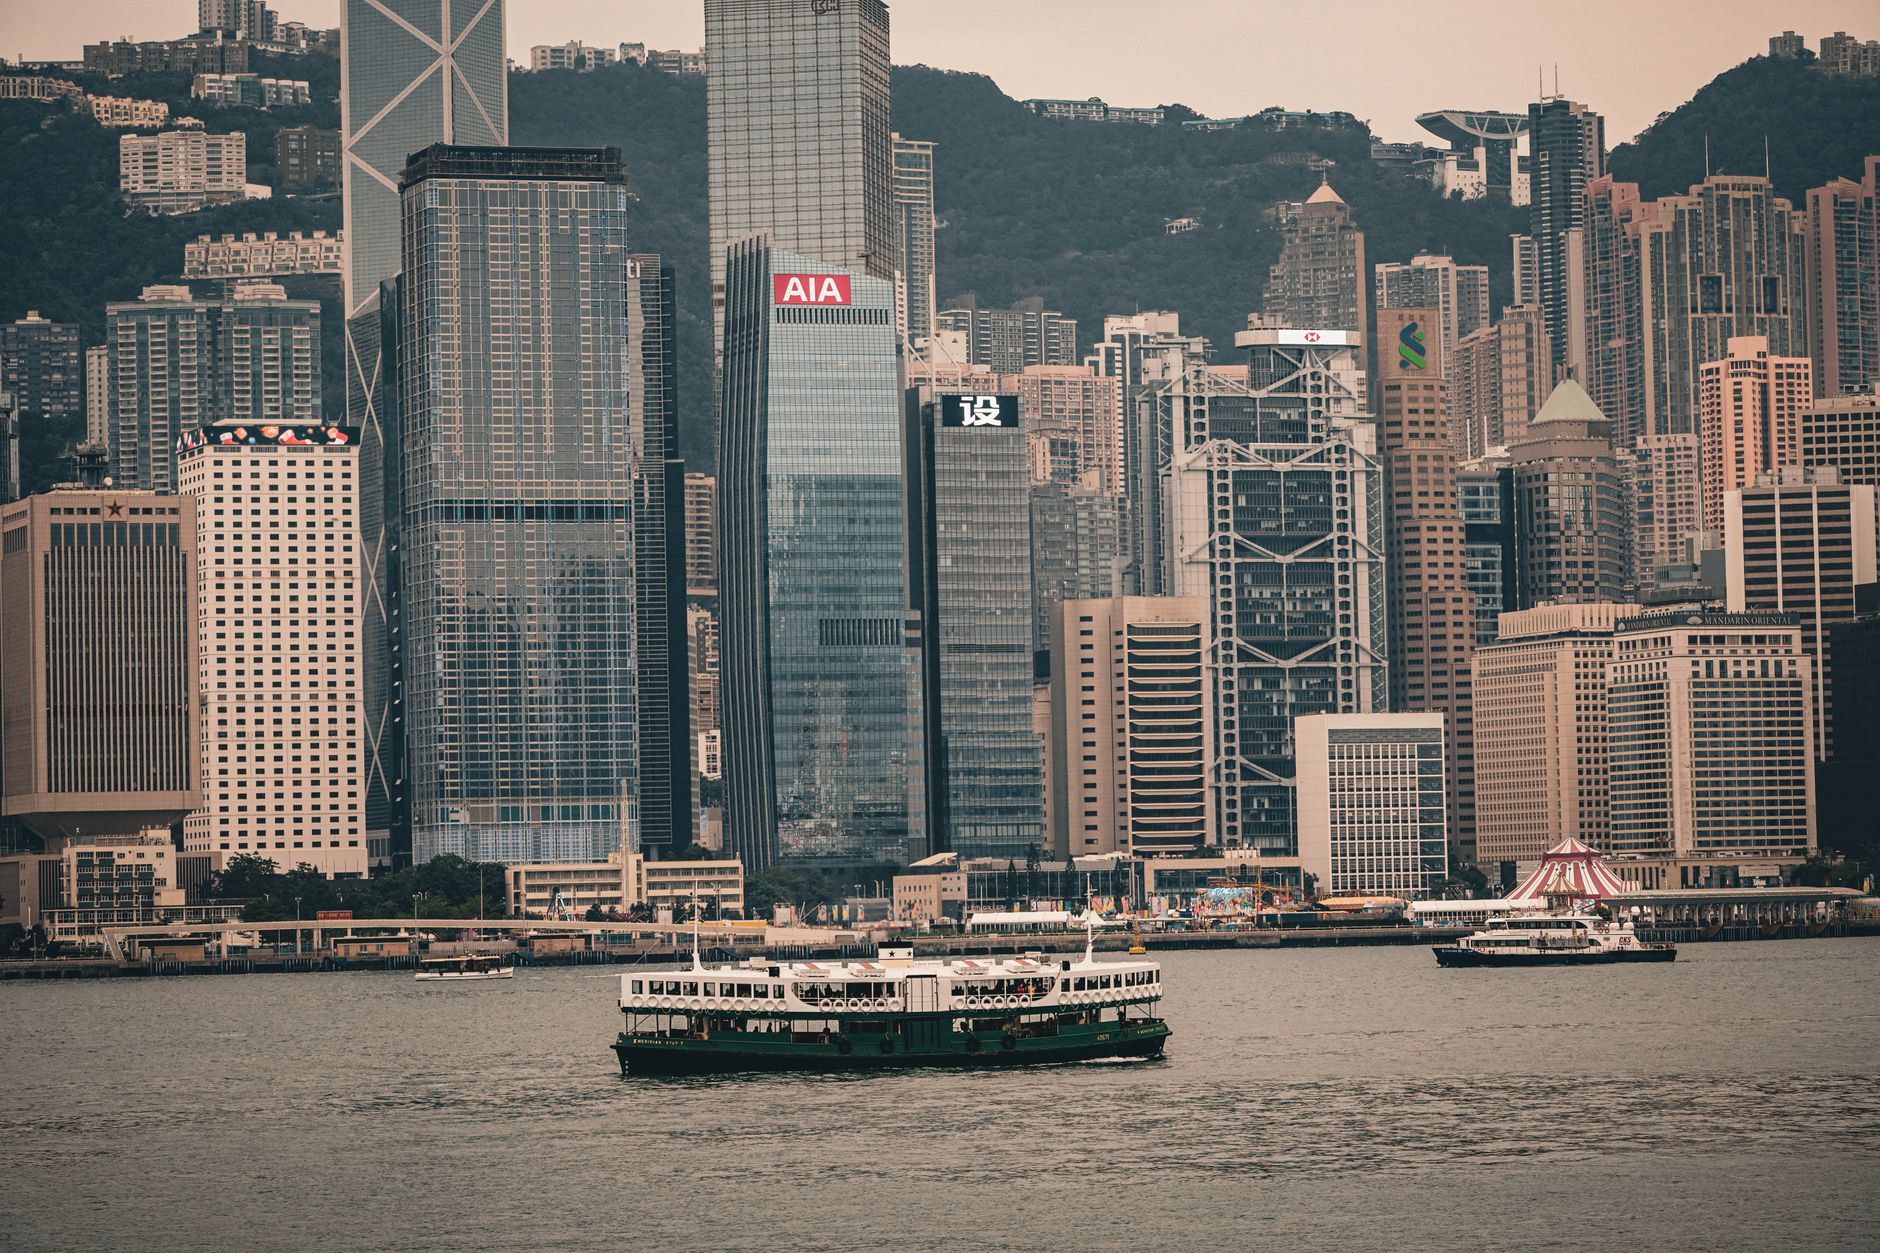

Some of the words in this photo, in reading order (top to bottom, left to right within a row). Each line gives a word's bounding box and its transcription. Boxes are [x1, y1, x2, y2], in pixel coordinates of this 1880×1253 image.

[782, 276, 843, 303] AIA
[959, 395, 1002, 427] 设
[1704, 616, 1750, 625] MANDARIN
[1751, 616, 1792, 625] ORIENTAL
